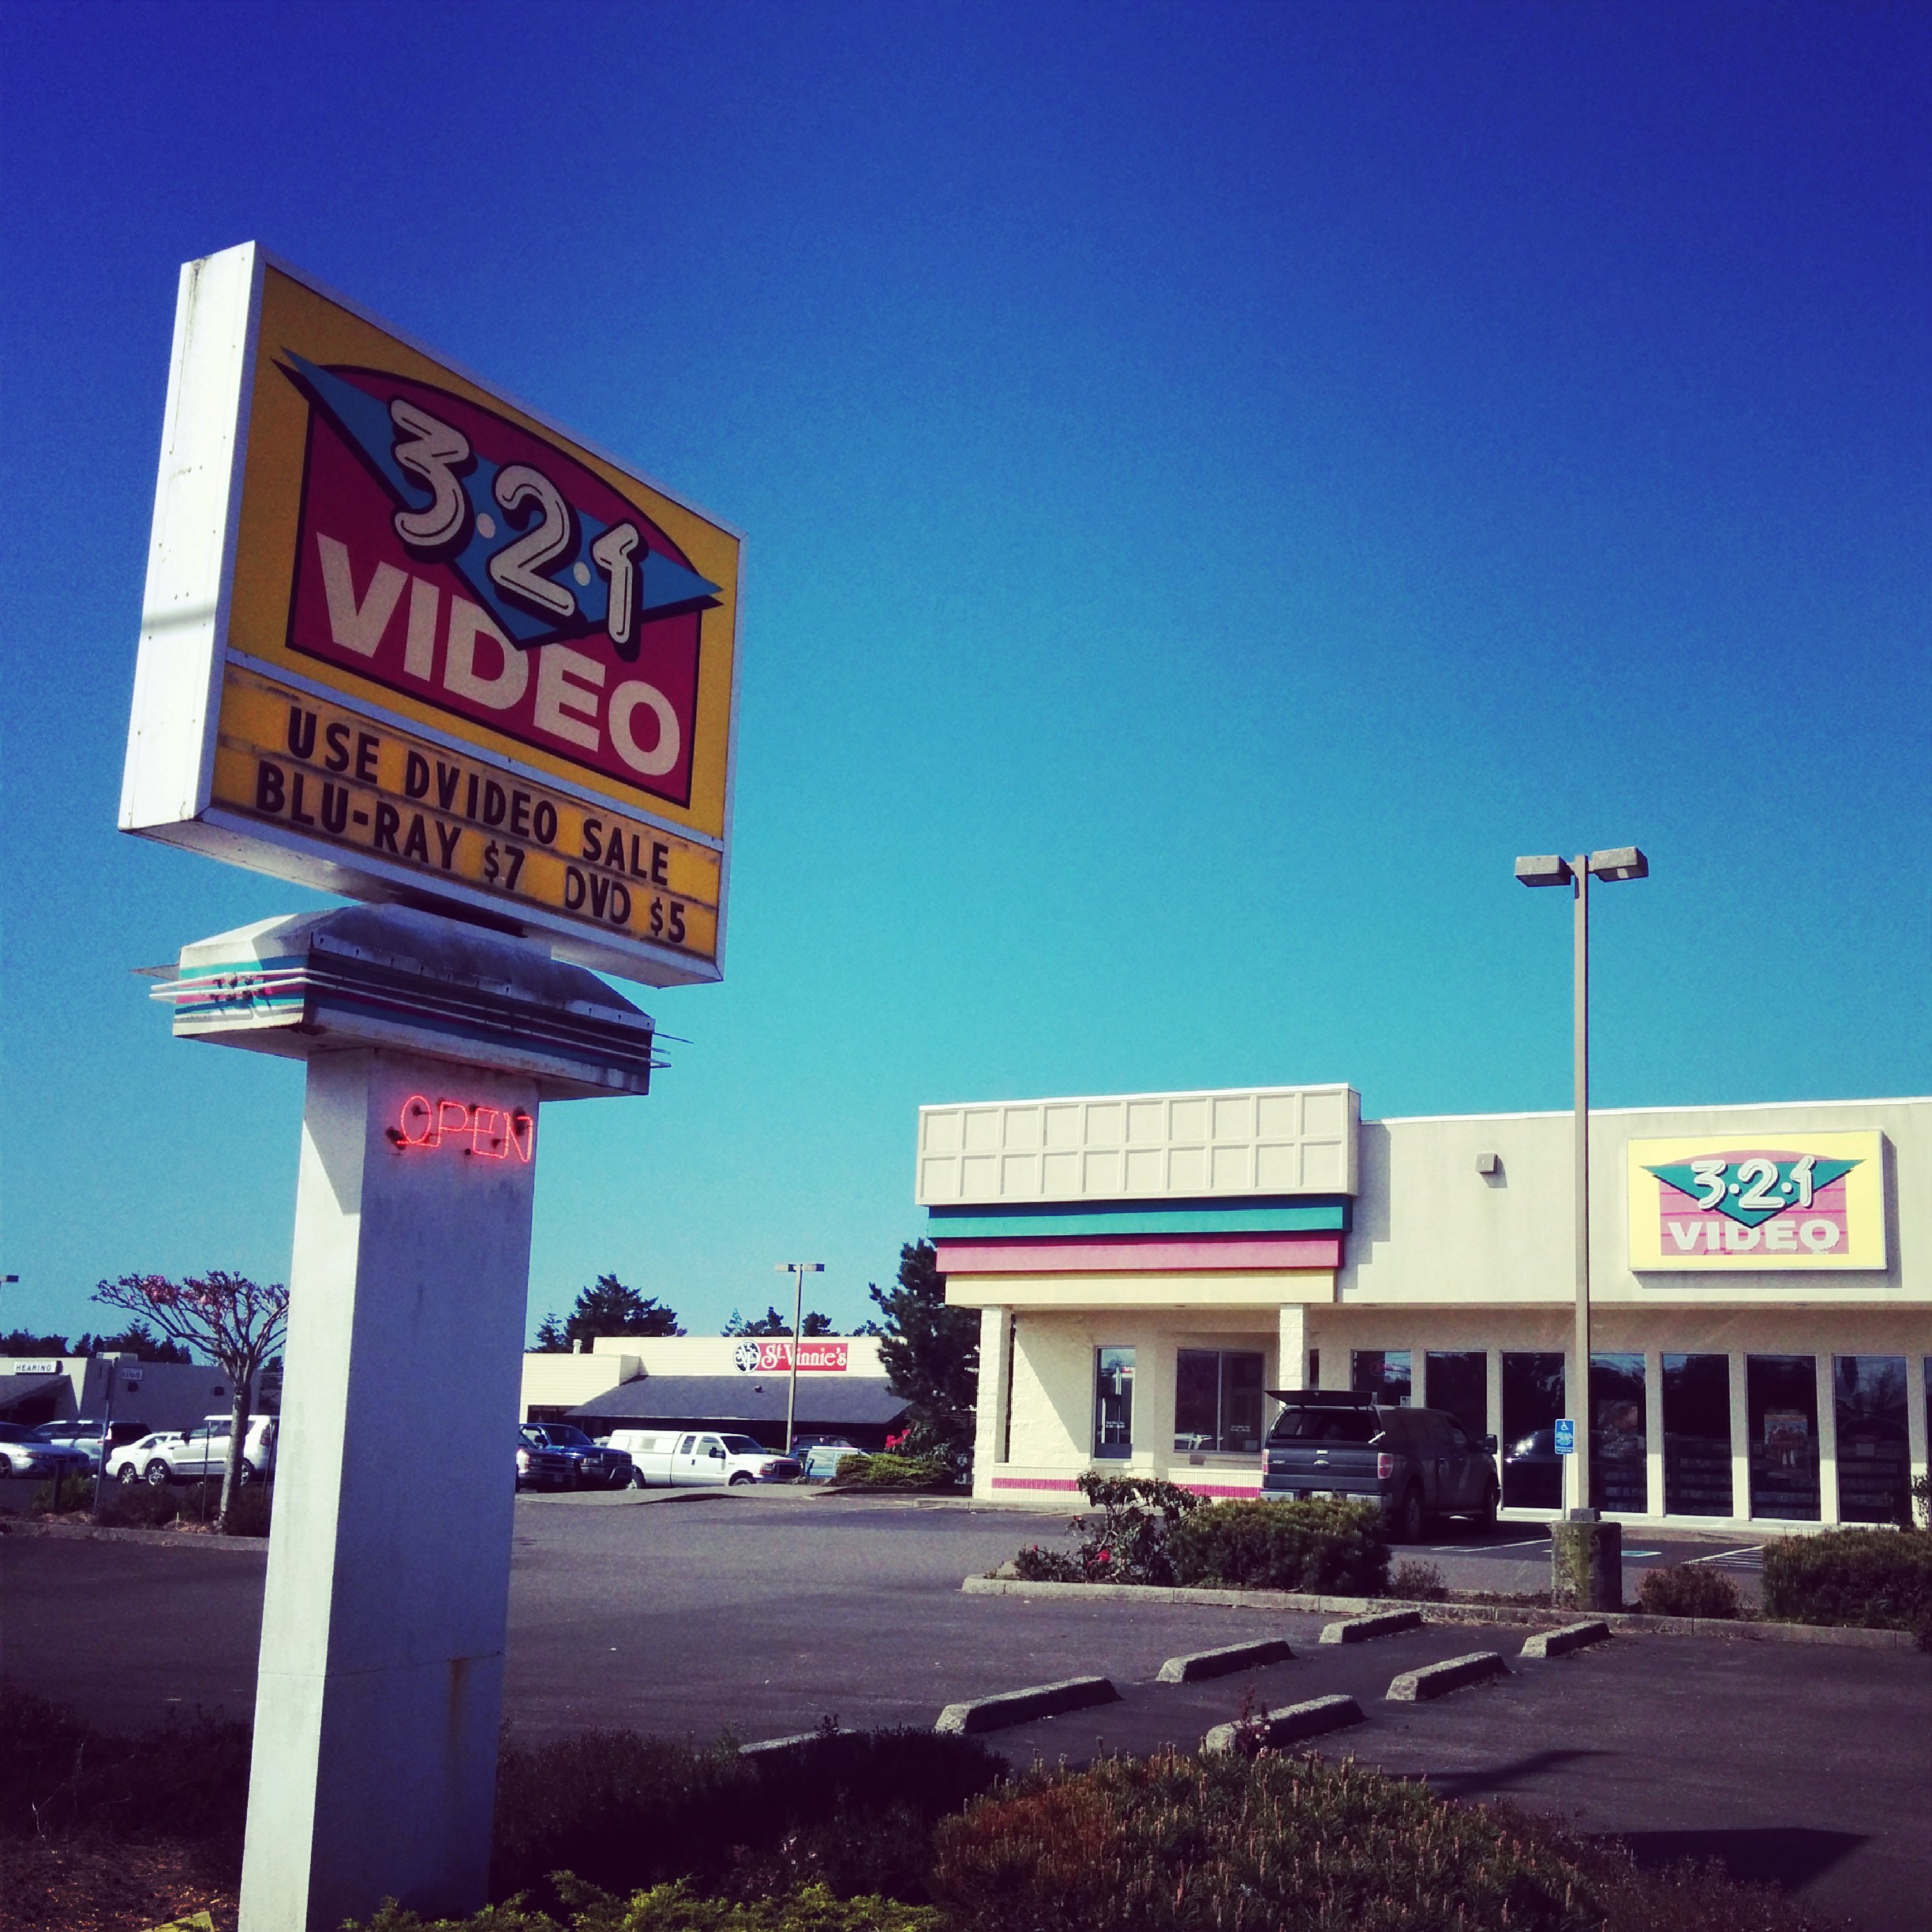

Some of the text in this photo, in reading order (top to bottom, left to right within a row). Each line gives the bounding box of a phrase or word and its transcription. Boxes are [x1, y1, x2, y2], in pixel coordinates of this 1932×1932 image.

[316, 531, 681, 777] VIDEO
[256, 759, 686, 943] BLU-RAY $7 DVD $5
[287, 706, 669, 886] USE DVIDEO SALE
[397, 1095, 534, 1163] OPEN
[1668, 1219, 1840, 1251] VIDEO
